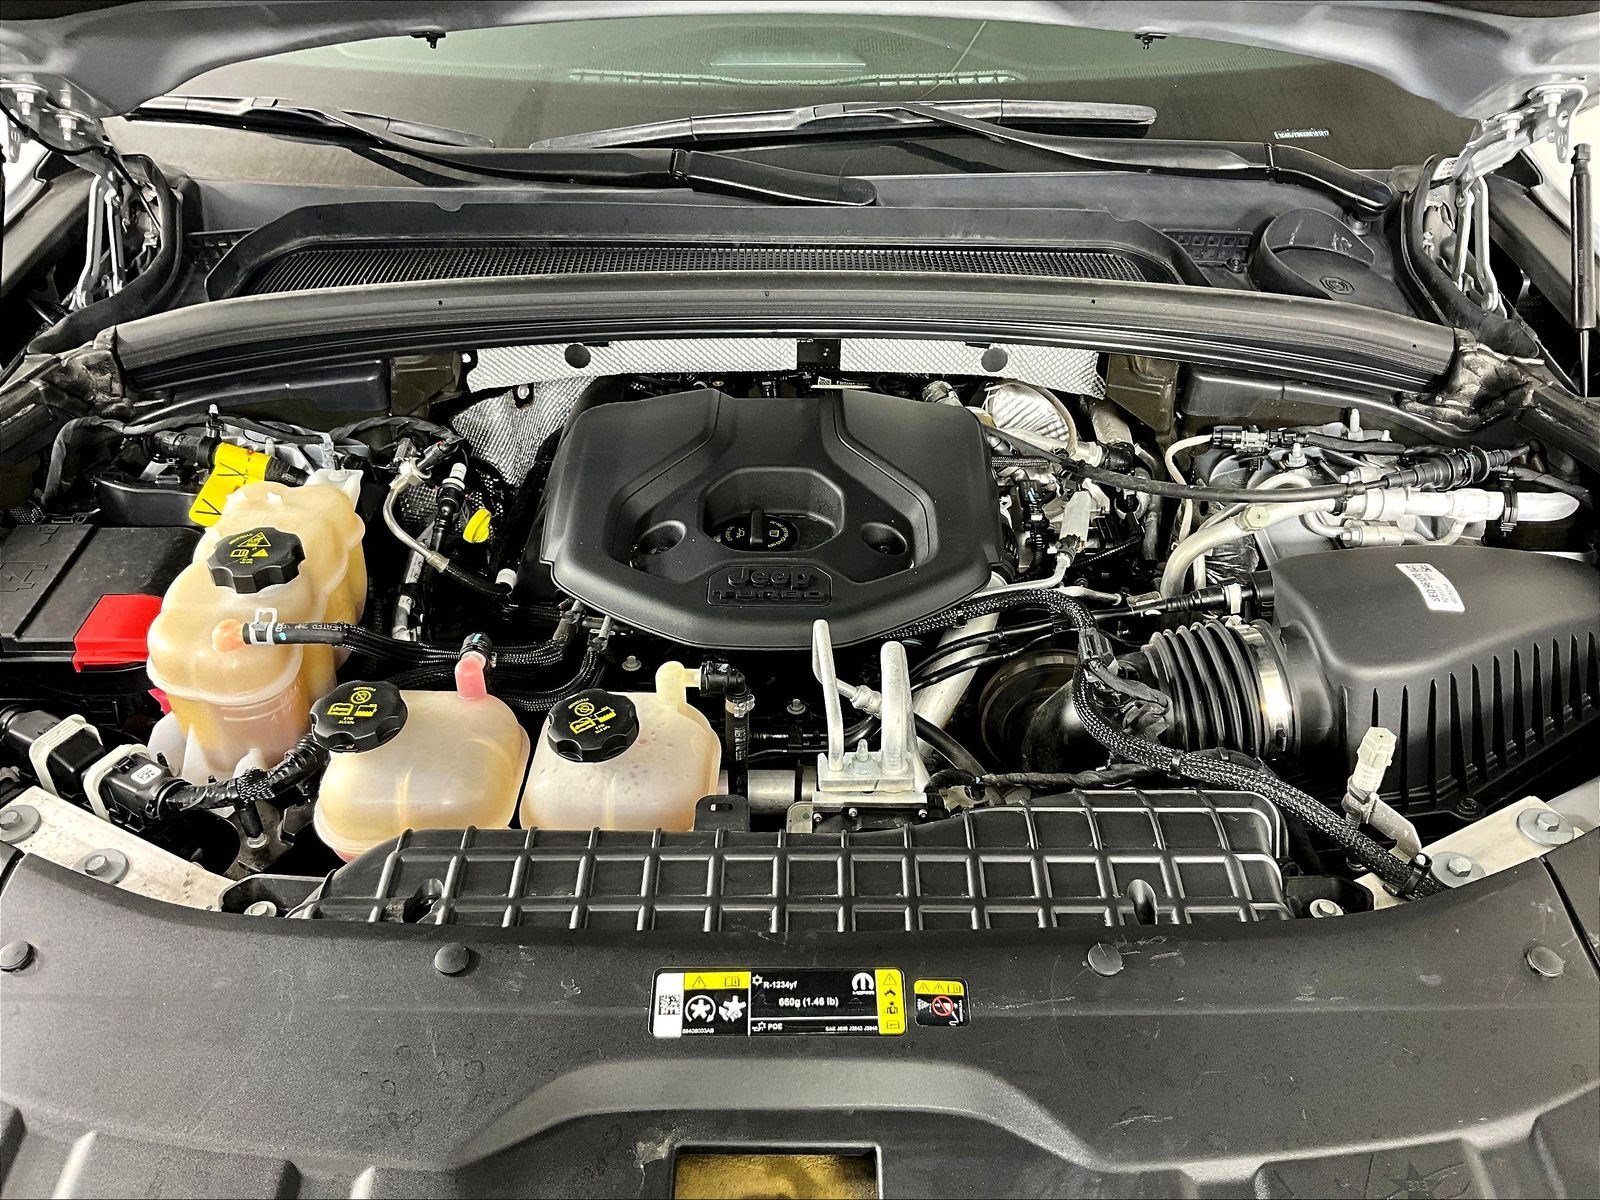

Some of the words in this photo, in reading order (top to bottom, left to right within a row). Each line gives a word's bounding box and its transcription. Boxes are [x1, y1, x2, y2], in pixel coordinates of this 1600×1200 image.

[727, 566, 811, 590] Jeep
[763, 980, 798, 991] R-1234yf
[826, 997, 839, 1008] lb)
